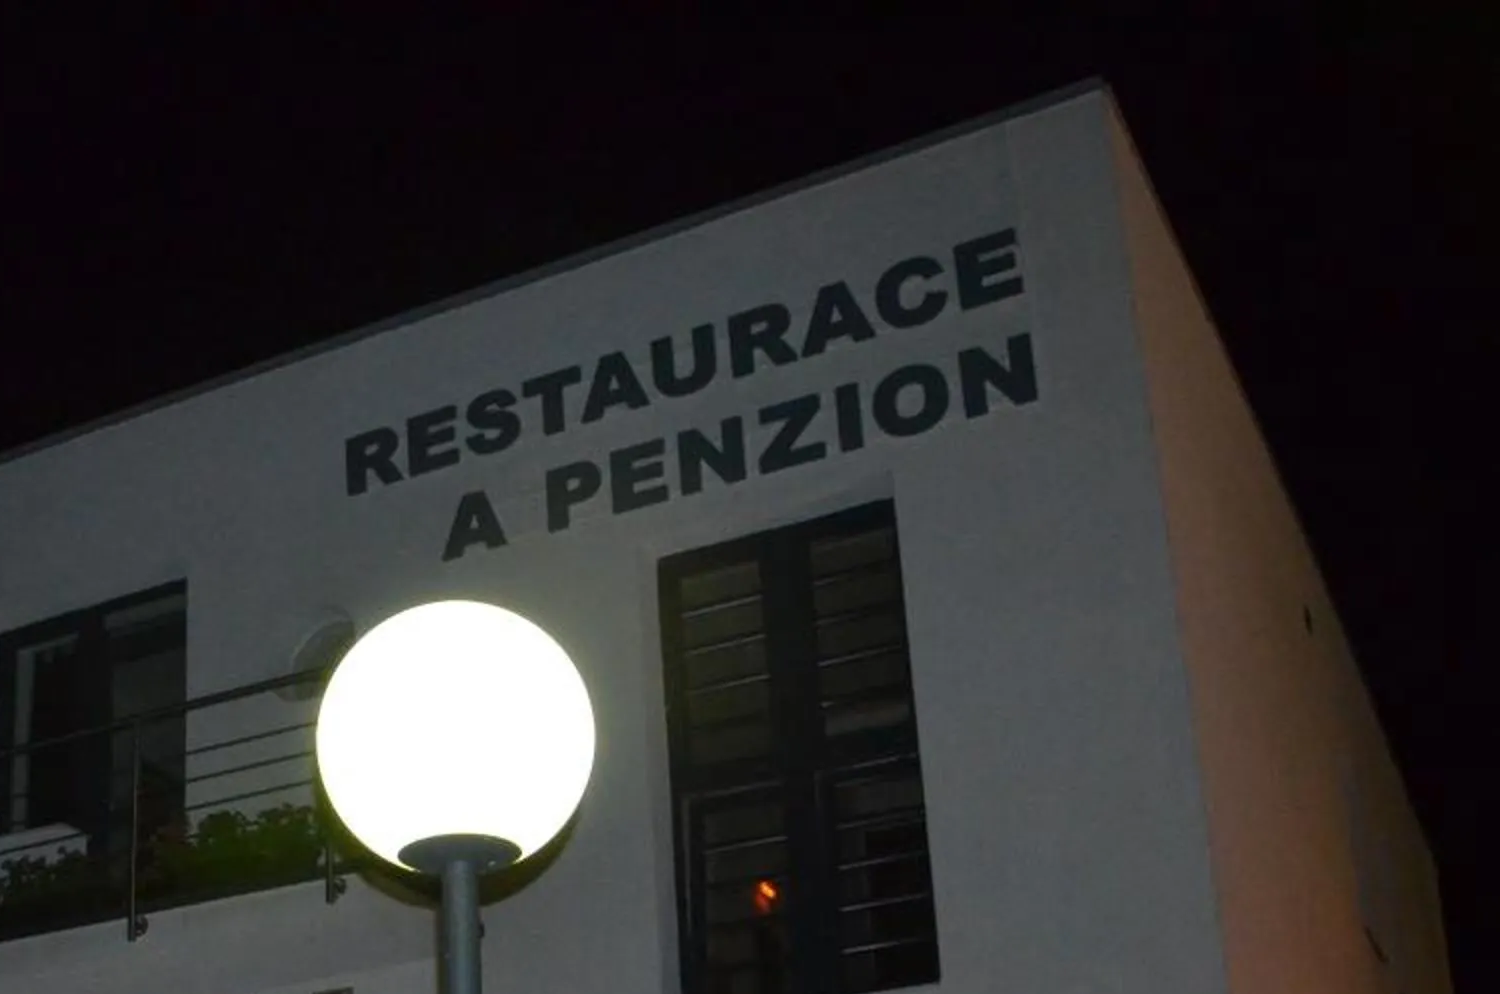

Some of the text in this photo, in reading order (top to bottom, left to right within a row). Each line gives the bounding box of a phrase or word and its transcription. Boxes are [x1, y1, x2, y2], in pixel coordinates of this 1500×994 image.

[345, 227, 1025, 496] RESTAURACE
[441, 332, 1039, 562] A PENZION
